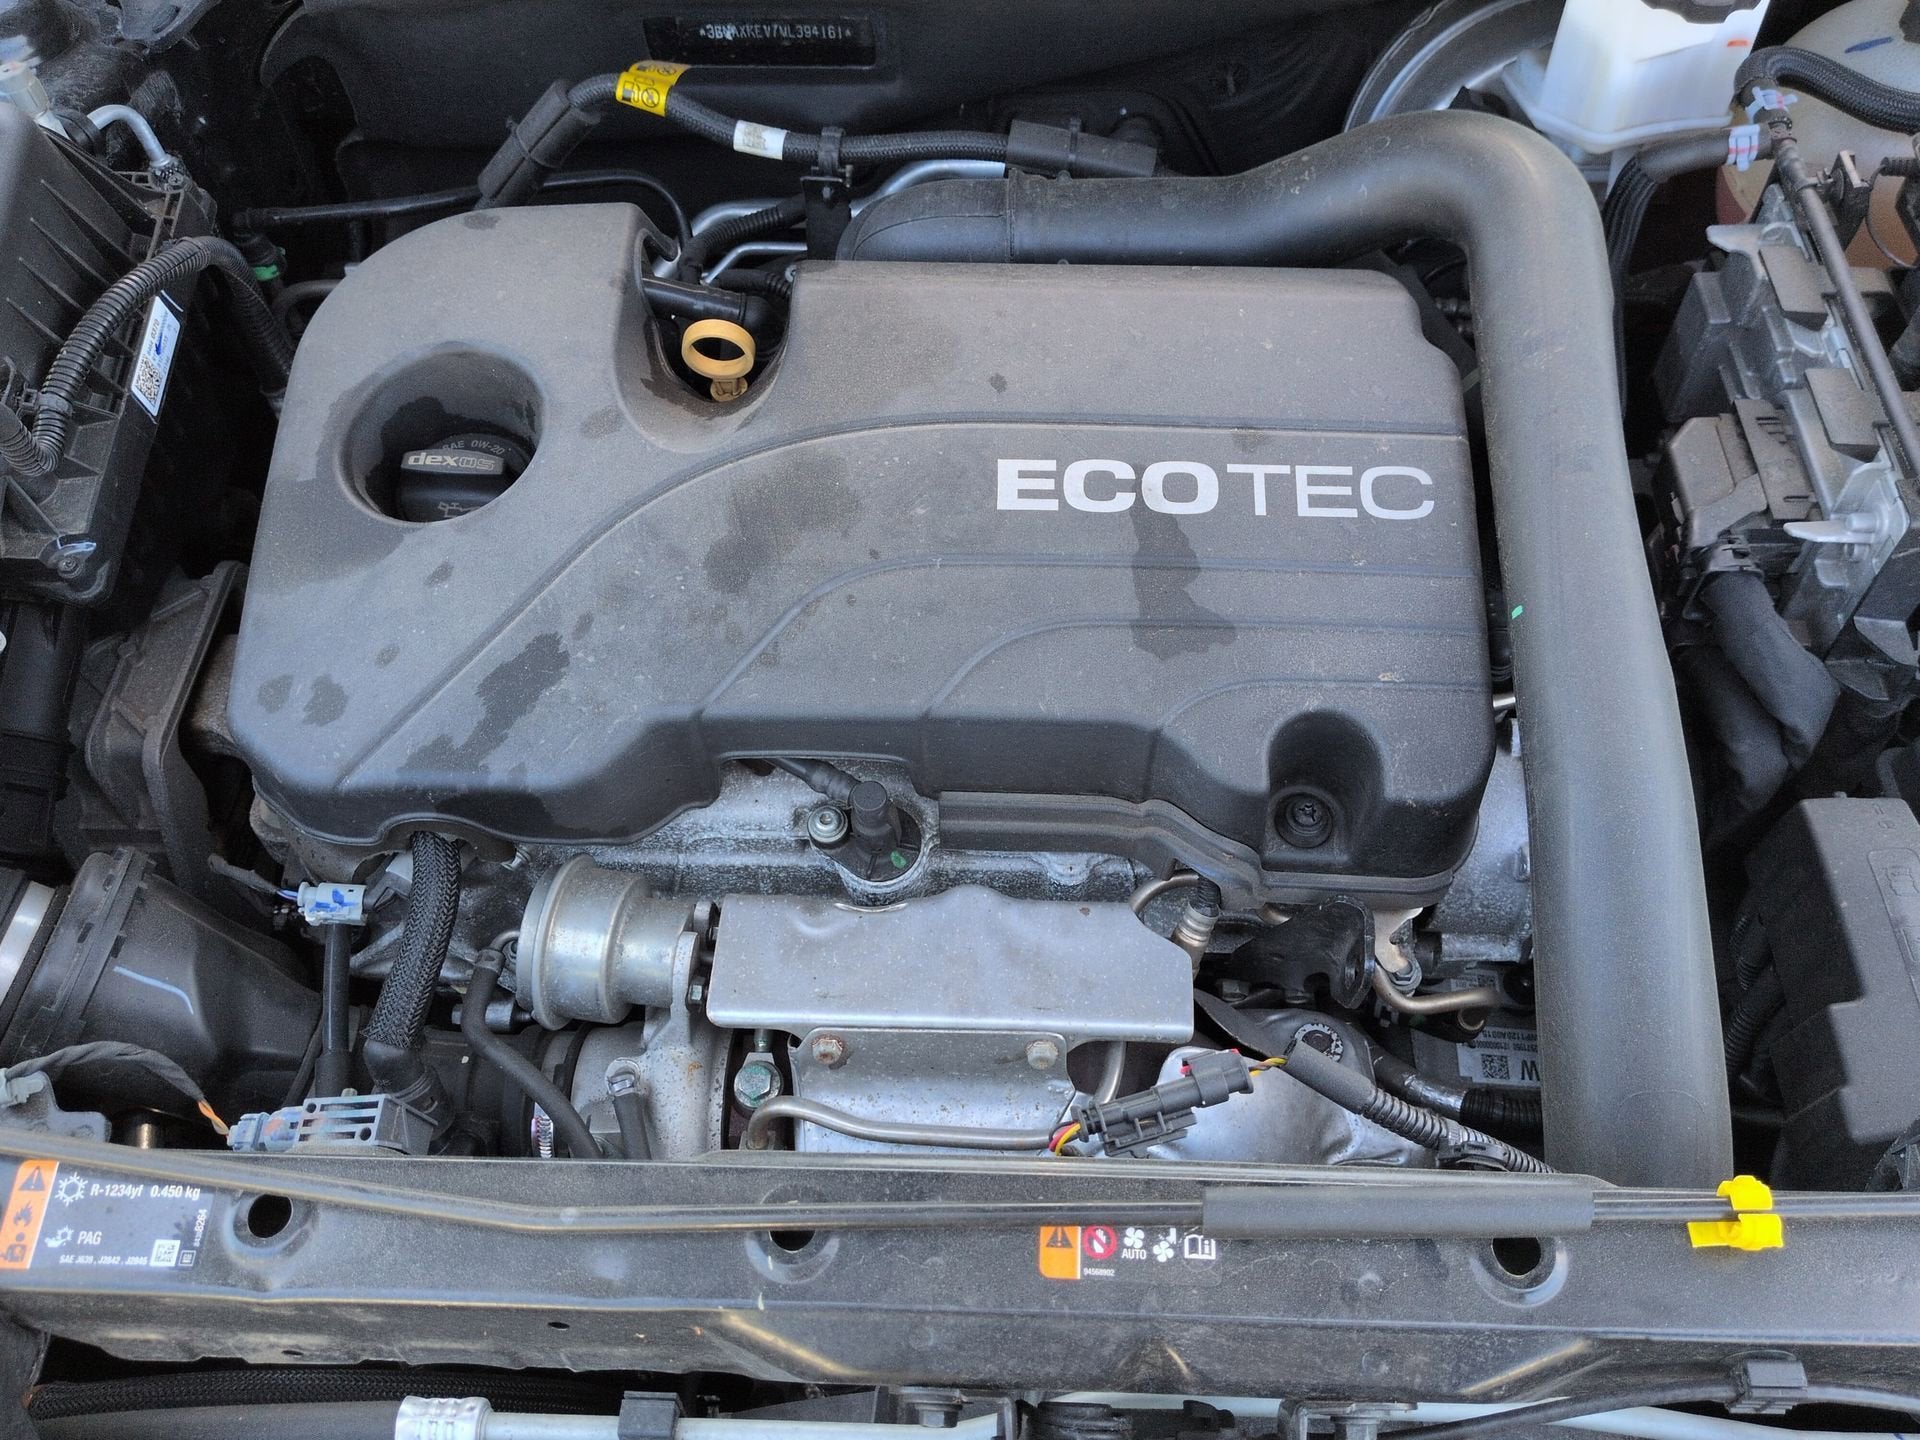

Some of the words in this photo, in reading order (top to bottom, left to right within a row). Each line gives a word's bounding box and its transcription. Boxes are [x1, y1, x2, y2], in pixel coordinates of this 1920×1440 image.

[471, 439, 505, 455] 0W-20
[408, 452, 495, 471] dexos
[996, 458, 1435, 520] ECOTEC
[90, 1183, 144, 1200] R-1234yf
[150, 1184, 183, 1198] 0.450
[185, 1184, 201, 1201] kg
[77, 1230, 103, 1245] PAG
[59, 1254, 75, 1265] SAE
[1121, 1248, 1147, 1260] AUTO
